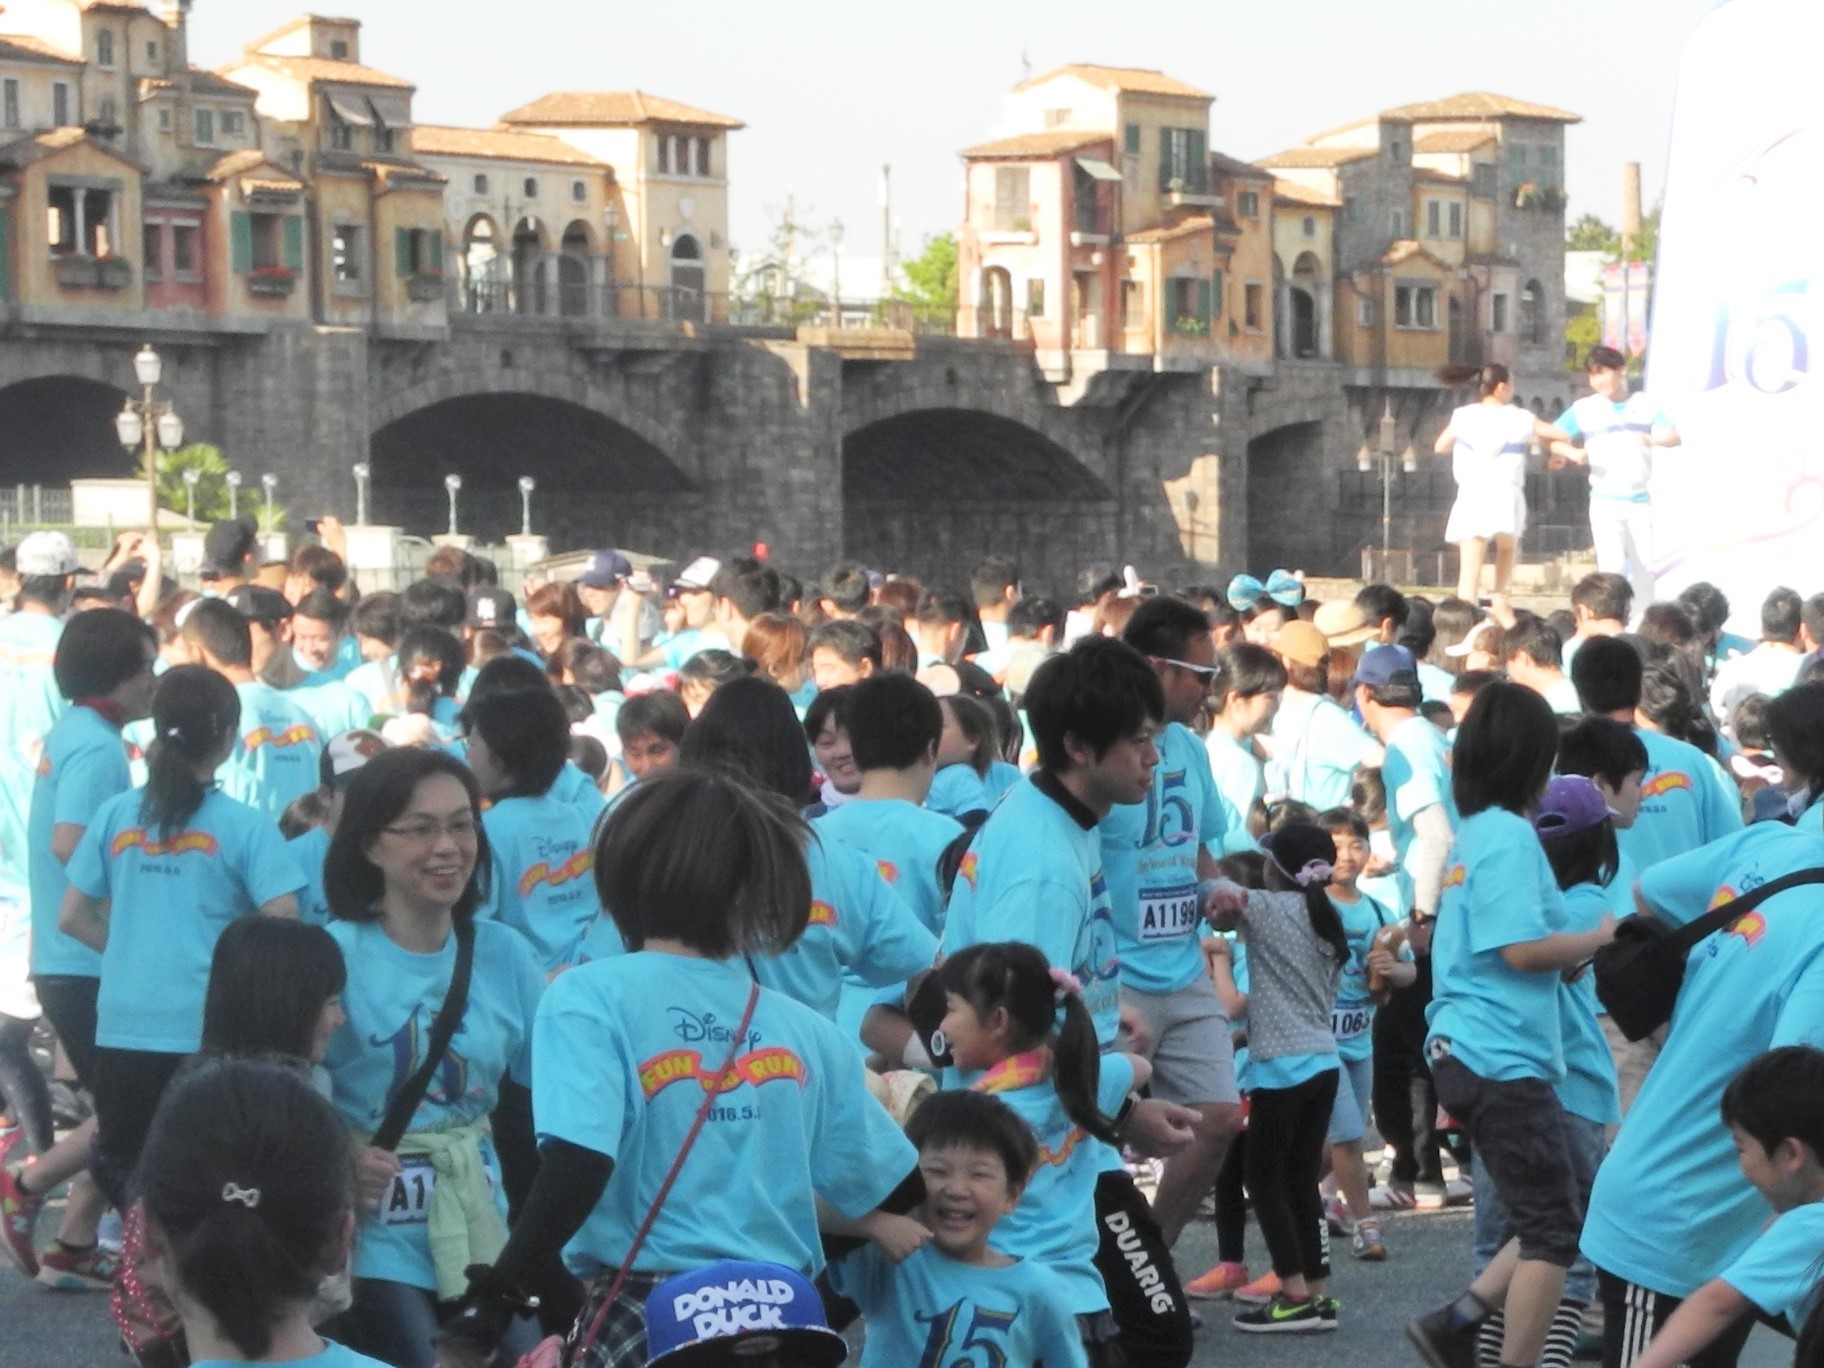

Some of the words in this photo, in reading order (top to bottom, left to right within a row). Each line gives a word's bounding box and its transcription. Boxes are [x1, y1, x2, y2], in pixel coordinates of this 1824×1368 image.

[1700, 277, 1811, 394] 15
[1134, 767, 1195, 849] 15
[640, 1054, 693, 1090] FUN
[1104, 1209, 1177, 1316] DUARIG
[672, 1278, 796, 1323] DONALD
[693, 1303, 789, 1342] DUCK
